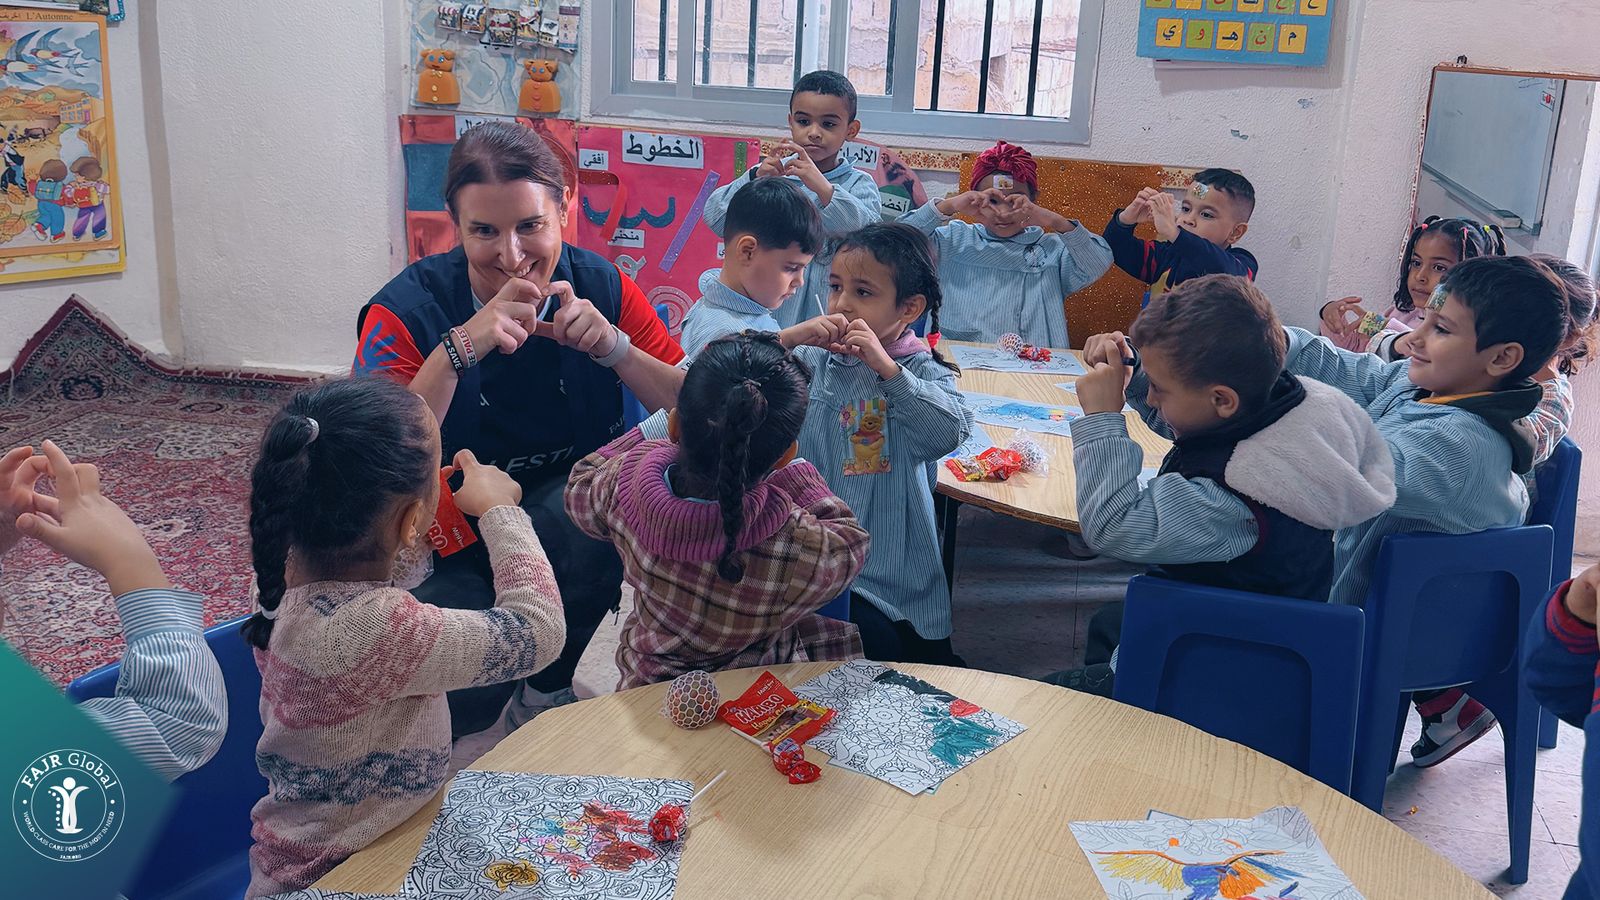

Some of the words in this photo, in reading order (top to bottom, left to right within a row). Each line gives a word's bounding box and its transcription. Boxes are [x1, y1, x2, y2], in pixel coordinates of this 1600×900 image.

[26, 12, 73, 21] L'Automne
[1162, 25, 1177, 41] ي
[1195, 28, 1205, 41] و
[1254, 30, 1267, 46] ن
[626, 134, 699, 162] الخطوط
[881, 199, 907, 213] أخض
[447, 347, 463, 370] SAVE
